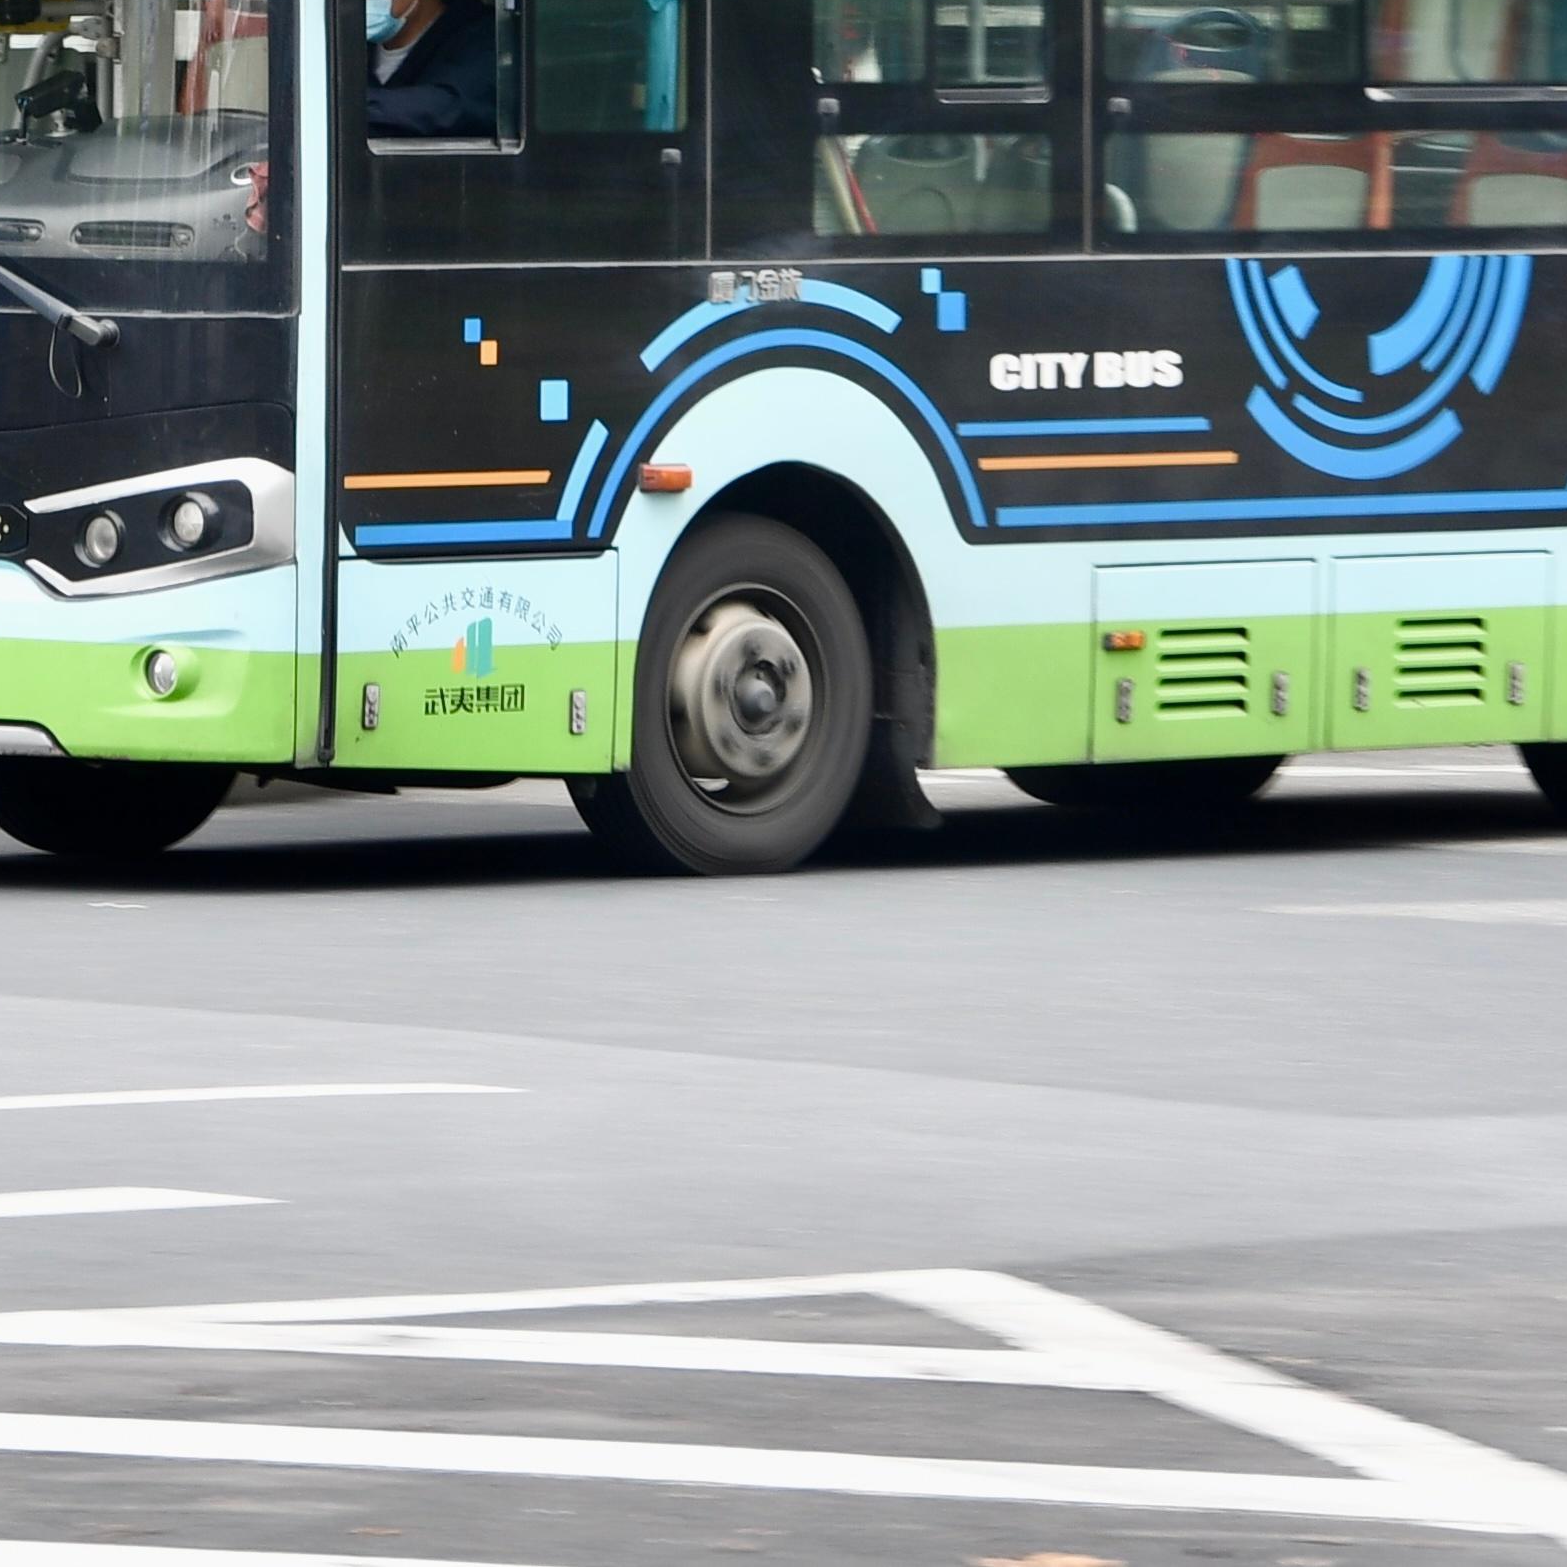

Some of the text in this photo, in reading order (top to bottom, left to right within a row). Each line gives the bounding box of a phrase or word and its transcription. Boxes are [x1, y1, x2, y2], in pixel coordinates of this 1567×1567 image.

[990, 348, 1185, 392] CITY BUS
[389, 585, 564, 659] 南平公共交通有限公司
[423, 682, 526, 717] 武夷集团
